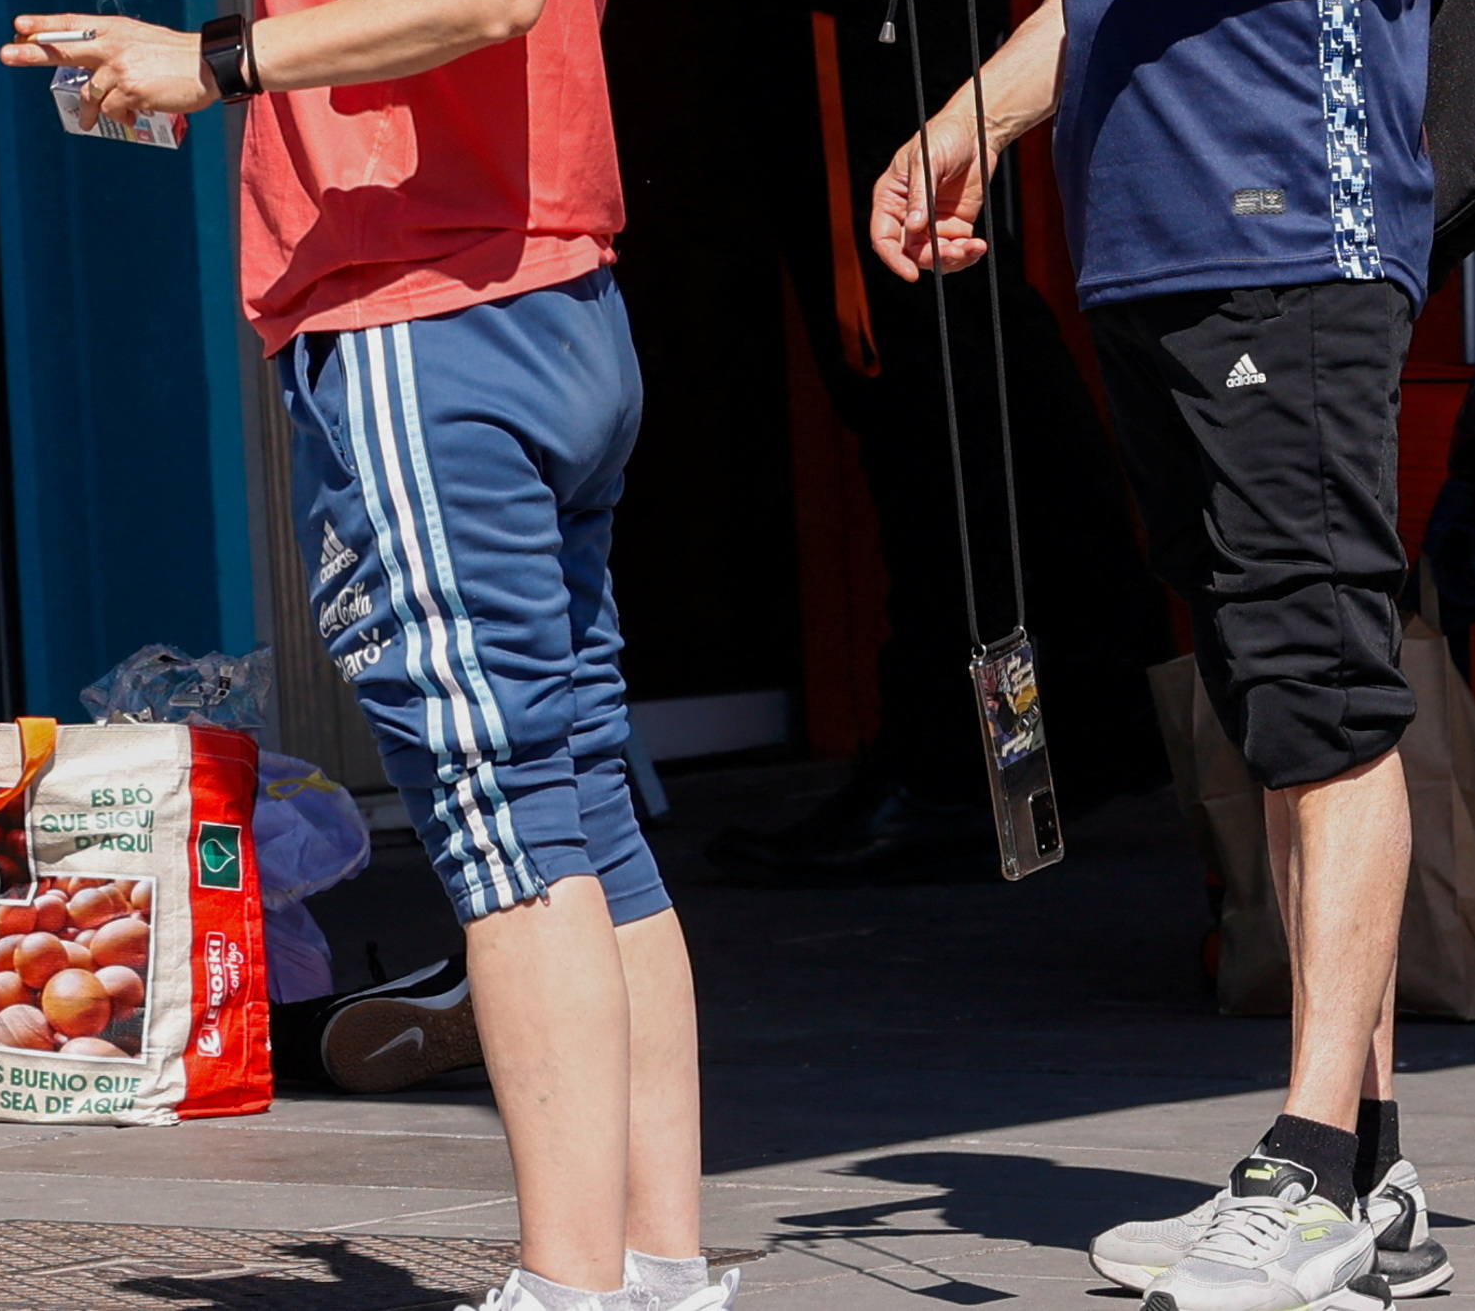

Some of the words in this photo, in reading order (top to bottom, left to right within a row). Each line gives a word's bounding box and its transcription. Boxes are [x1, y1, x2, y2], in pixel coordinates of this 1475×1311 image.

[1225, 372, 1267, 389] adidas
[319, 547, 359, 585] adidas
[90, 788, 116, 808] ES
[121, 782, 154, 807] BÓ
[39, 813, 88, 834] QUE
[94, 809, 155, 831] SIGUI
[74, 829, 154, 854] D'AQUÍ
[206, 938, 225, 1021] EROSKI
[226, 940, 245, 998] contigo
[9, 1066, 88, 1092] BUENO
[93, 1075, 142, 1094] QUE
[0, 1090, 38, 1114] SEA
[44, 1096, 75, 1115] DE
[77, 1094, 137, 1115] AQUÍ
